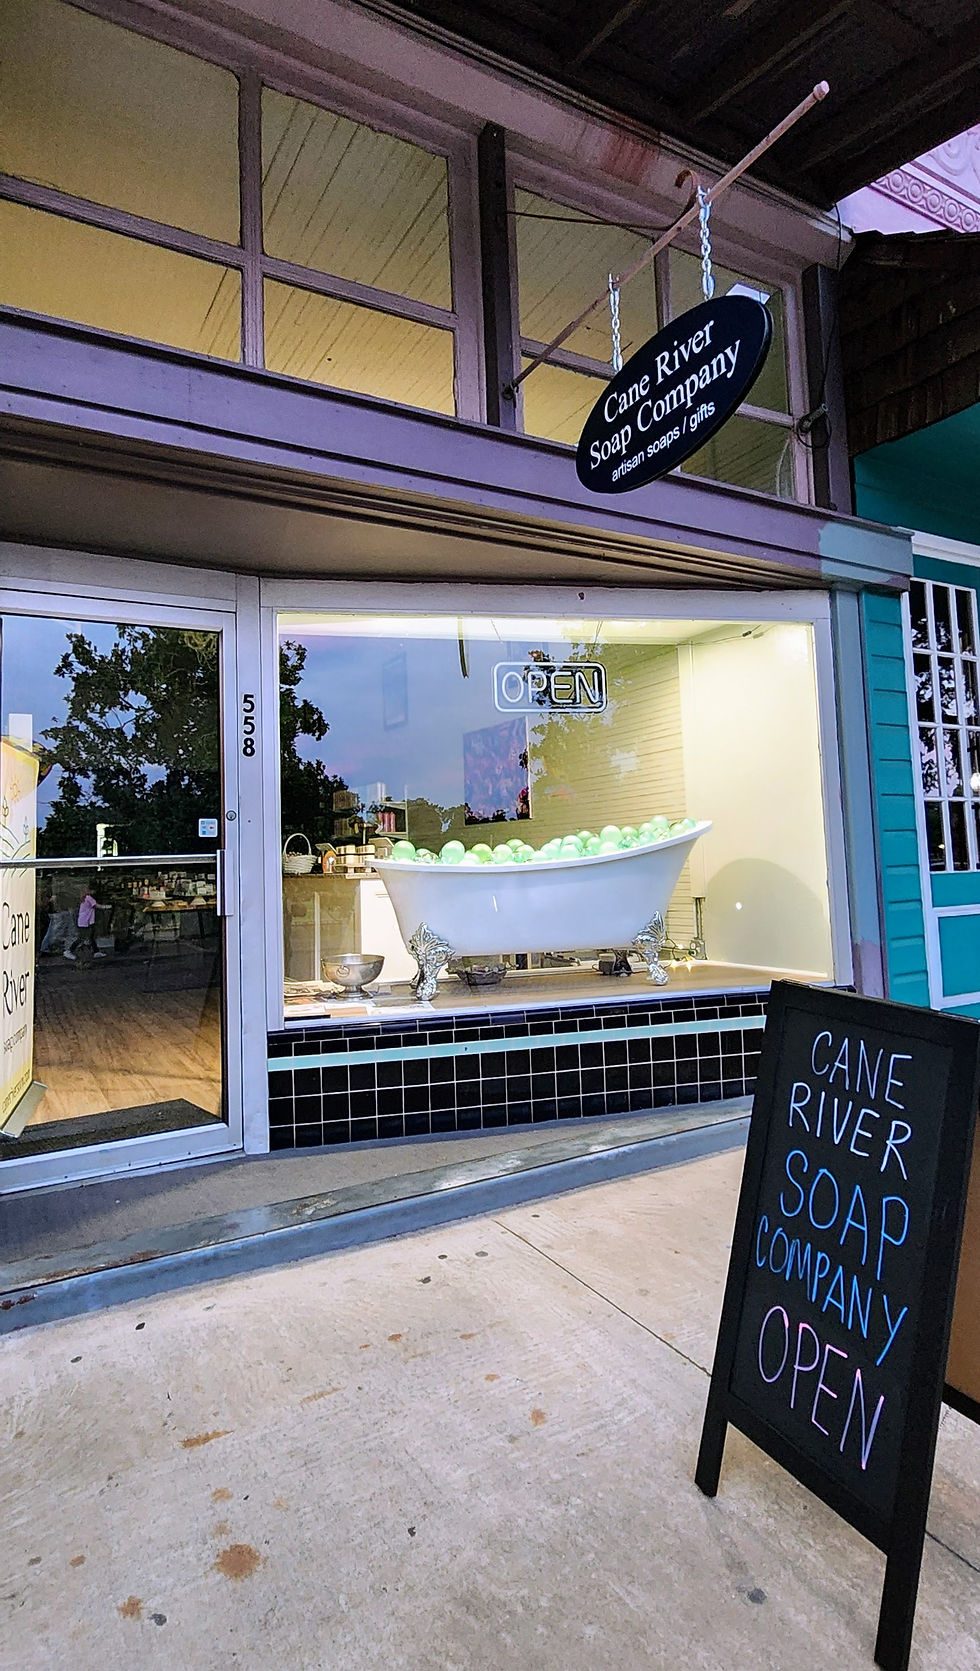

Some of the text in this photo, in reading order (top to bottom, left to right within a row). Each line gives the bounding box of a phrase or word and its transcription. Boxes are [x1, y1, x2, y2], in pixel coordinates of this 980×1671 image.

[590, 339, 741, 470] Soap Company
[603, 320, 715, 423] Cane River
[611, 450, 645, 482] artisan
[646, 425, 680, 458] soaps
[689, 401, 716, 432] gifts
[243, 694, 256, 757] 558
[502, 671, 600, 703] OPEN
[2, 902, 30, 950] Cane
[2, 970, 30, 1018] River
[811, 1031, 912, 1109] CANE
[788, 1082, 912, 1180] RIVER
[780, 1150, 909, 1281] SOAP
[756, 1215, 909, 1366] COMPANY
[758, 1305, 885, 1470] OPEN
